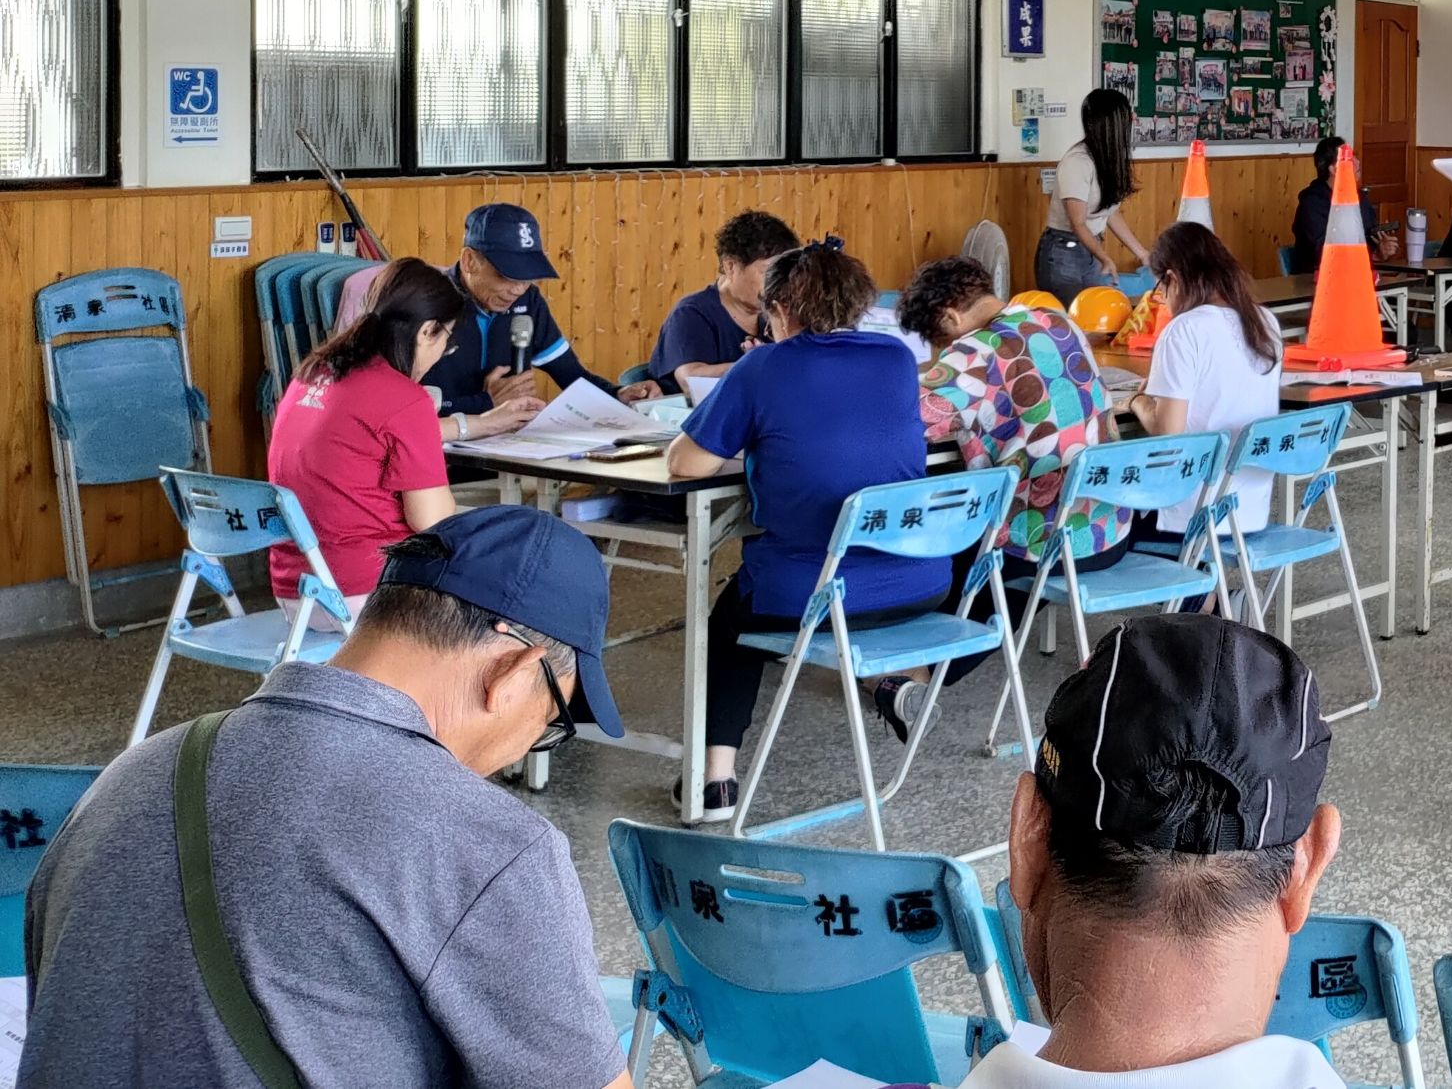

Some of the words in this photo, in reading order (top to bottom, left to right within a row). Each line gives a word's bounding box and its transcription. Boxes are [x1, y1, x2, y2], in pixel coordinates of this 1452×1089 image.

[173, 71, 192, 81] WC
[0, 808, 46, 849] 社
[1308, 954, 1361, 999] 區
